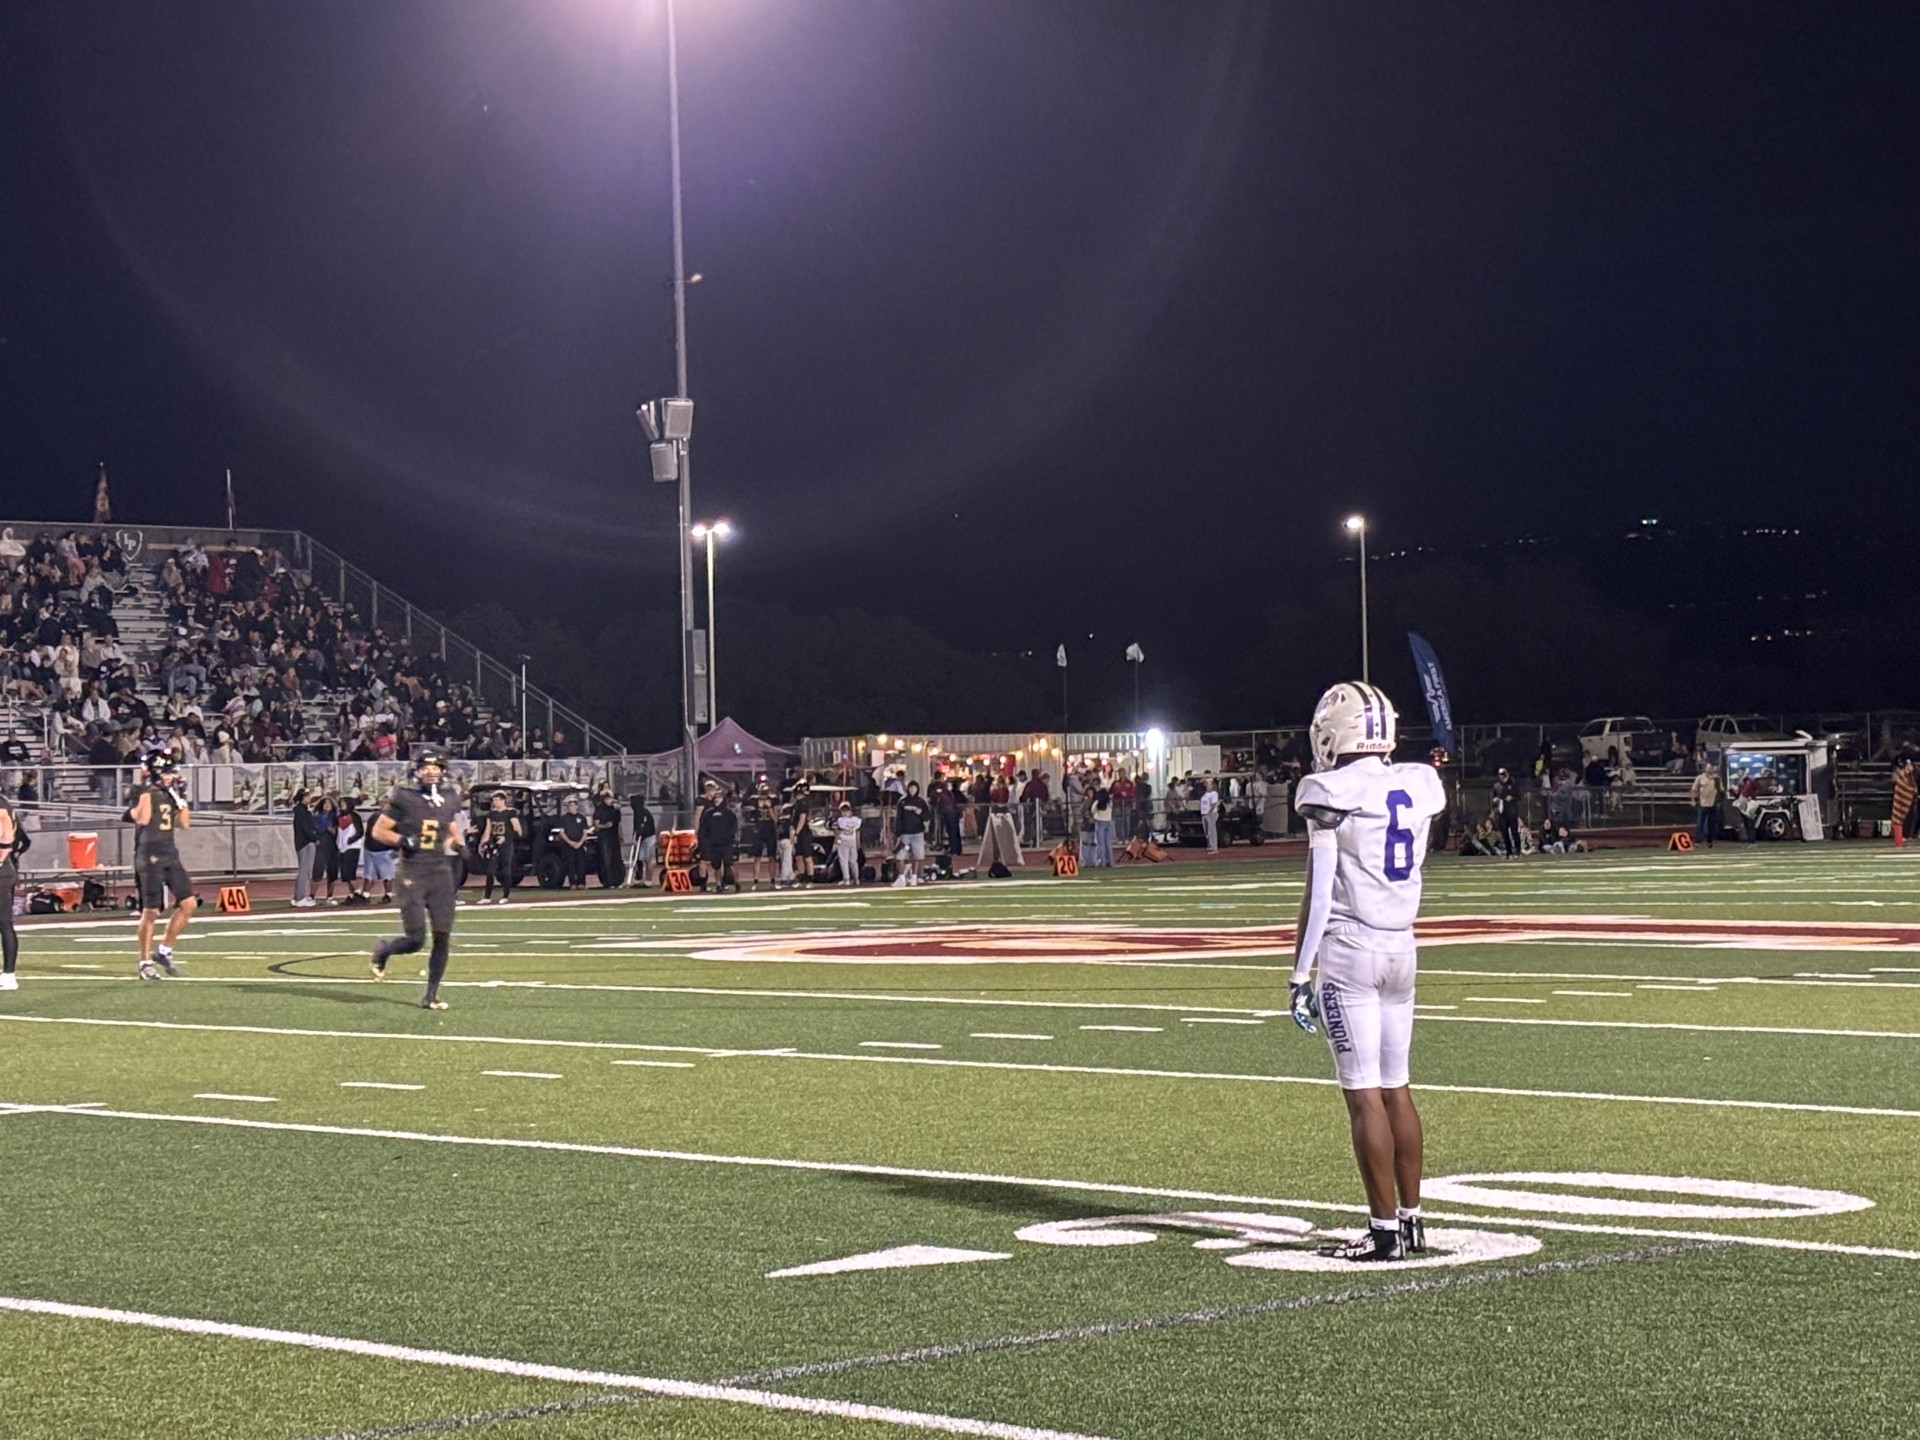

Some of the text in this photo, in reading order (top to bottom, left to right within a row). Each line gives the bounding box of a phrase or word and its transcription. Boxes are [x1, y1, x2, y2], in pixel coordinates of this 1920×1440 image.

[1427, 662, 1441, 689] FIRST
[159, 803, 172, 831] 3
[420, 819, 440, 850] 5
[1383, 789, 1415, 883] 6
[1676, 834, 1691, 849] G
[1059, 856, 1076, 875] 20
[671, 871, 690, 891] 30
[227, 888, 247, 910] 40
[1322, 982, 1353, 1055] PIONEERS
